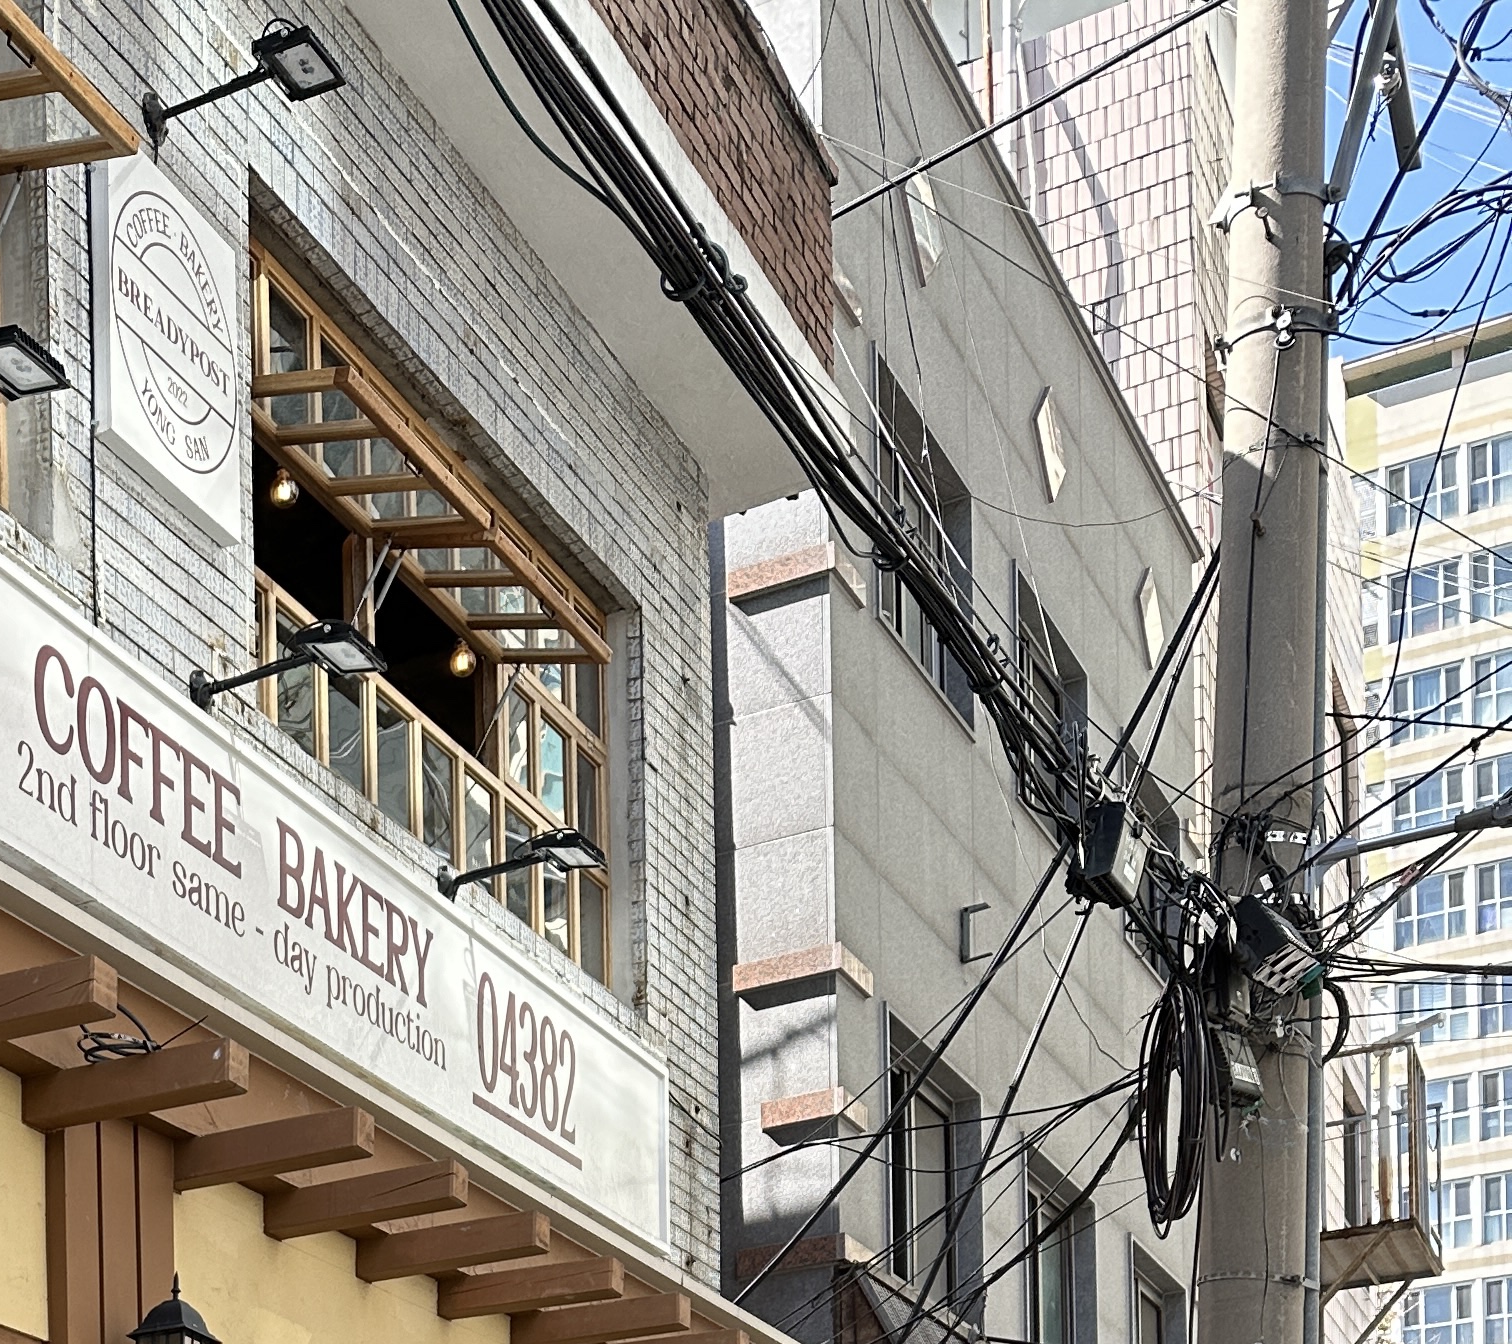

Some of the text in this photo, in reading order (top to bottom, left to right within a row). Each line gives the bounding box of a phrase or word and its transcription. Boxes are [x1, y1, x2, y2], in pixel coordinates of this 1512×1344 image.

[117, 265, 231, 397] BREADYPOST
[126, 207, 224, 333] COFFEE BAKERY
[140, 377, 210, 461] YONG SAN
[166, 376, 188, 408] 2022
[34, 645, 434, 1009] COFFEE BAKERY
[17, 740, 78, 828] 2nd
[90, 786, 162, 878] floor
[172, 858, 245, 937] same
[273, 920, 318, 998] day
[326, 966, 448, 1072] production
[475, 970, 578, 1146] 04382
